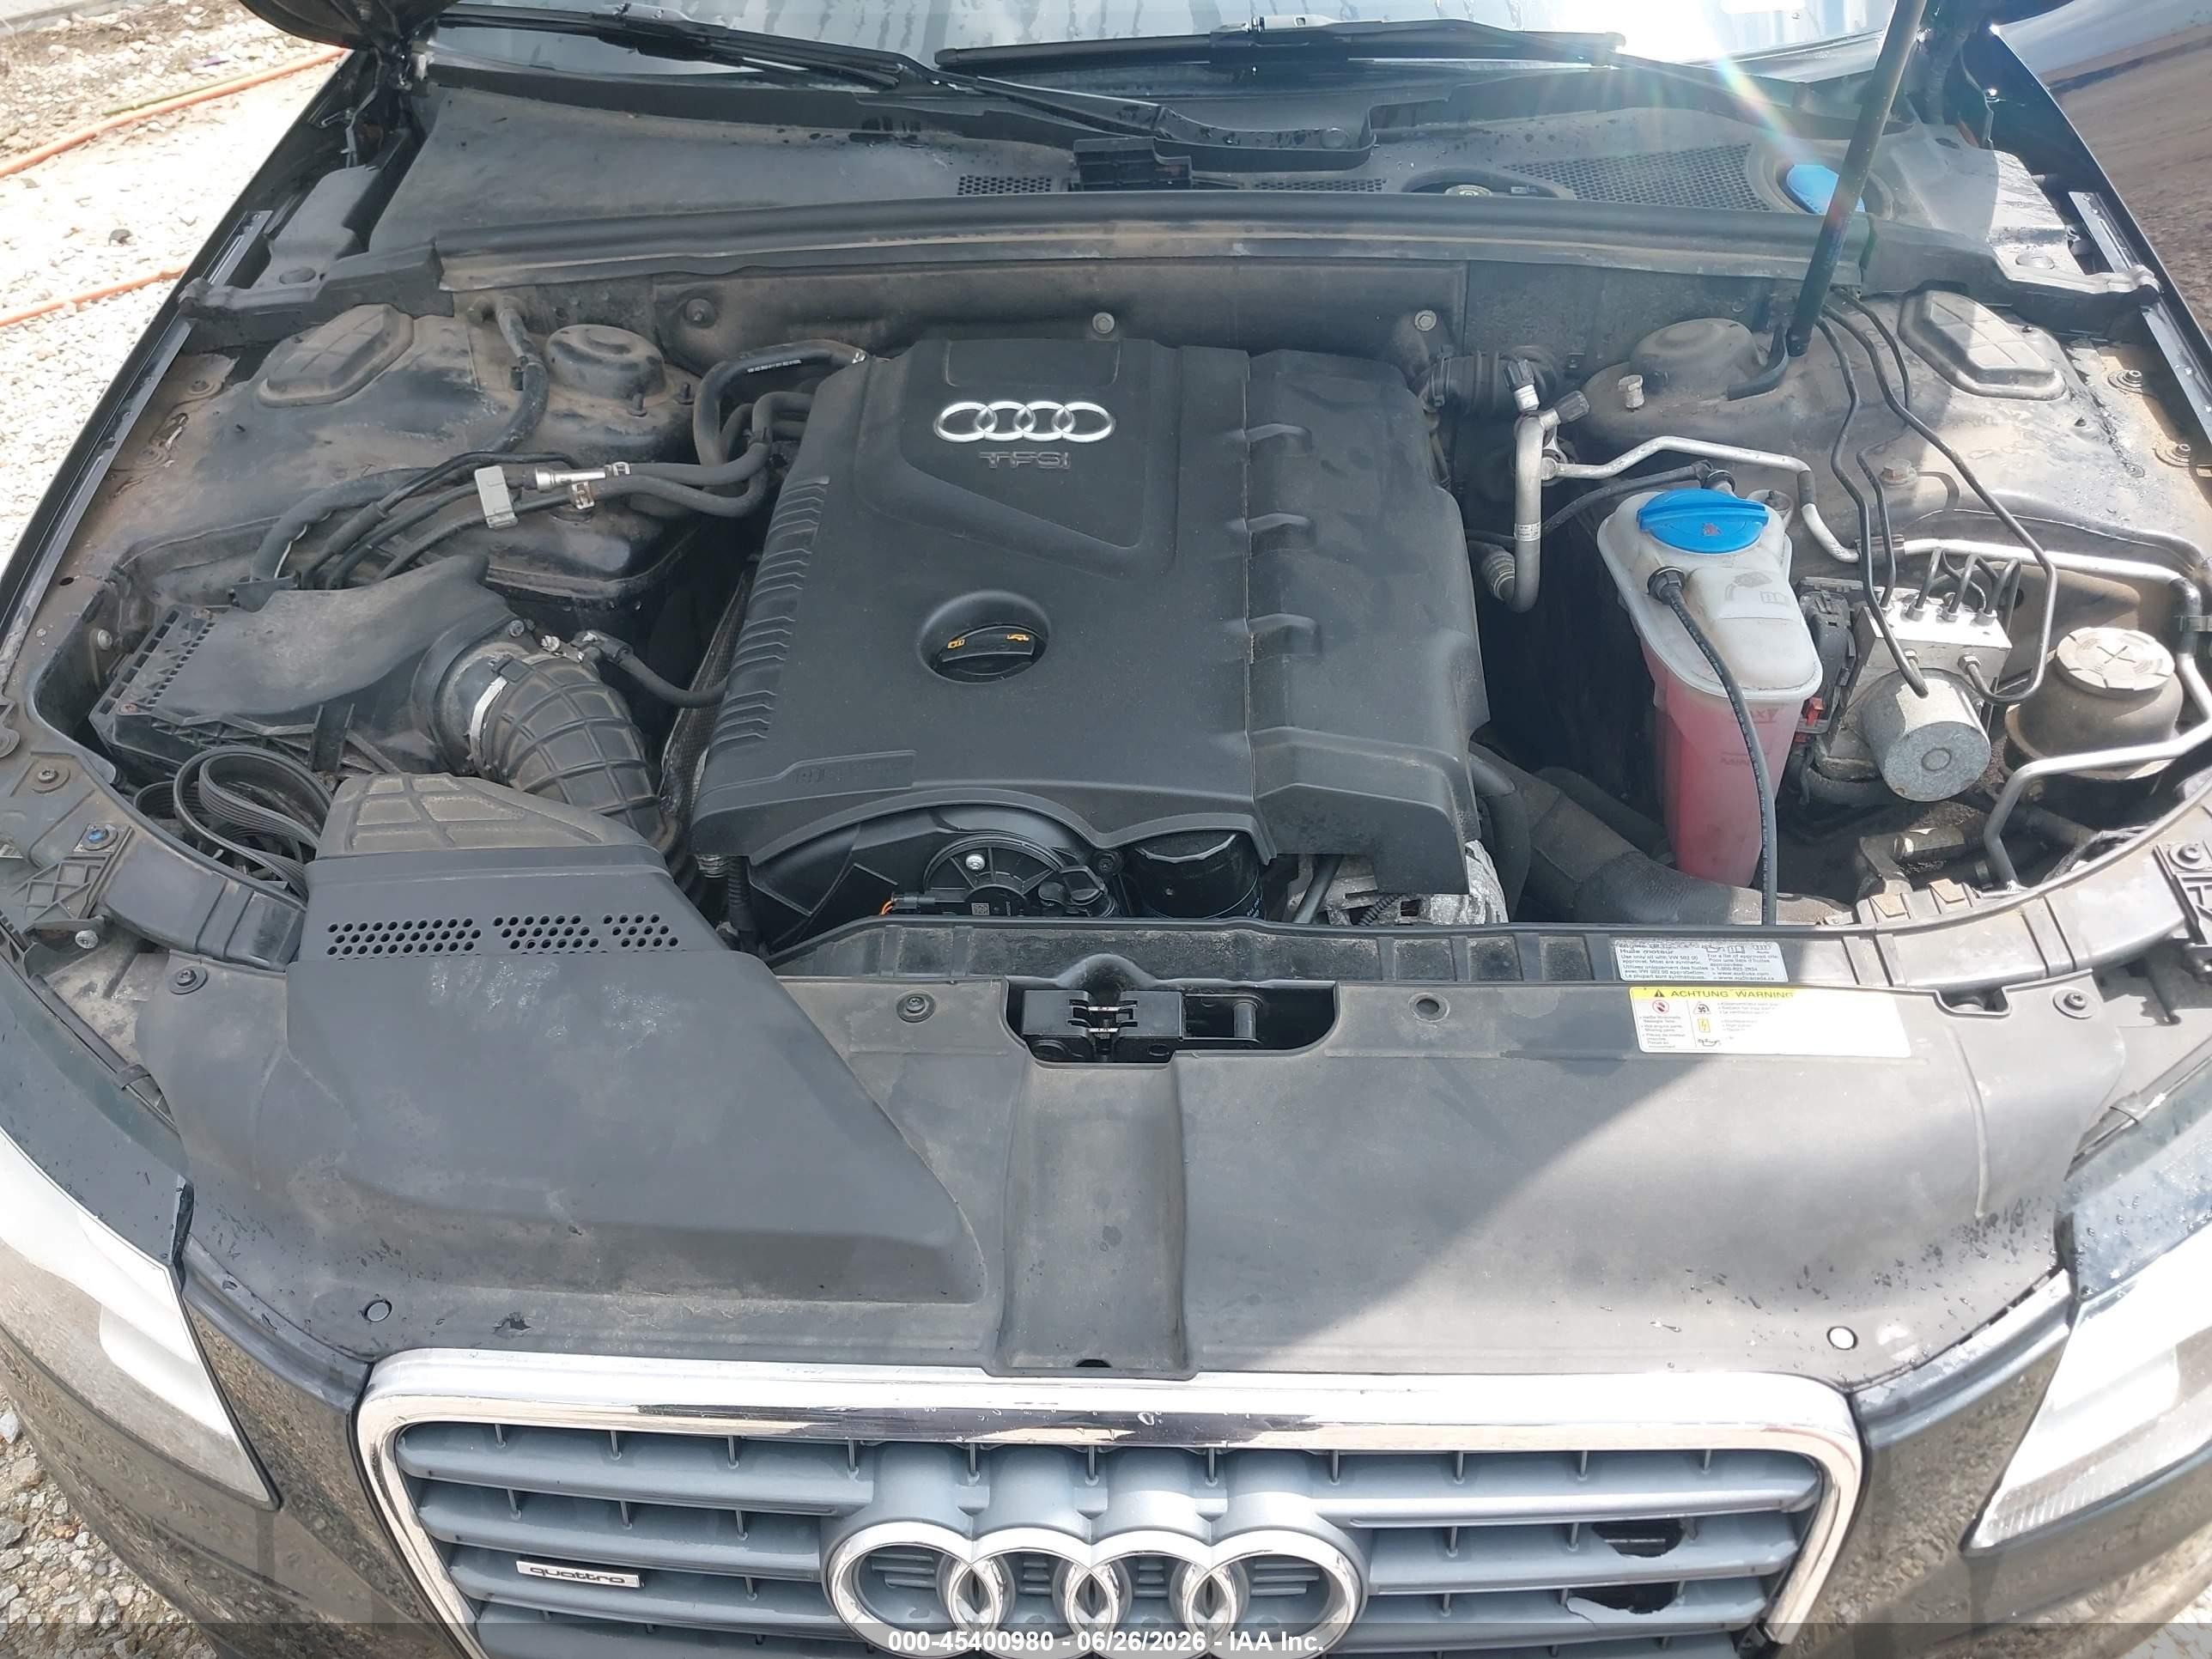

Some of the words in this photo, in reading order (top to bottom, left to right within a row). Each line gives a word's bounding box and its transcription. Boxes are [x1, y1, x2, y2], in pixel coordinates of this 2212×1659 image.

[979, 451, 1072, 470] TFSI
[1735, 990, 1795, 999] WARNING
[530, 1567, 625, 1583] quattro
